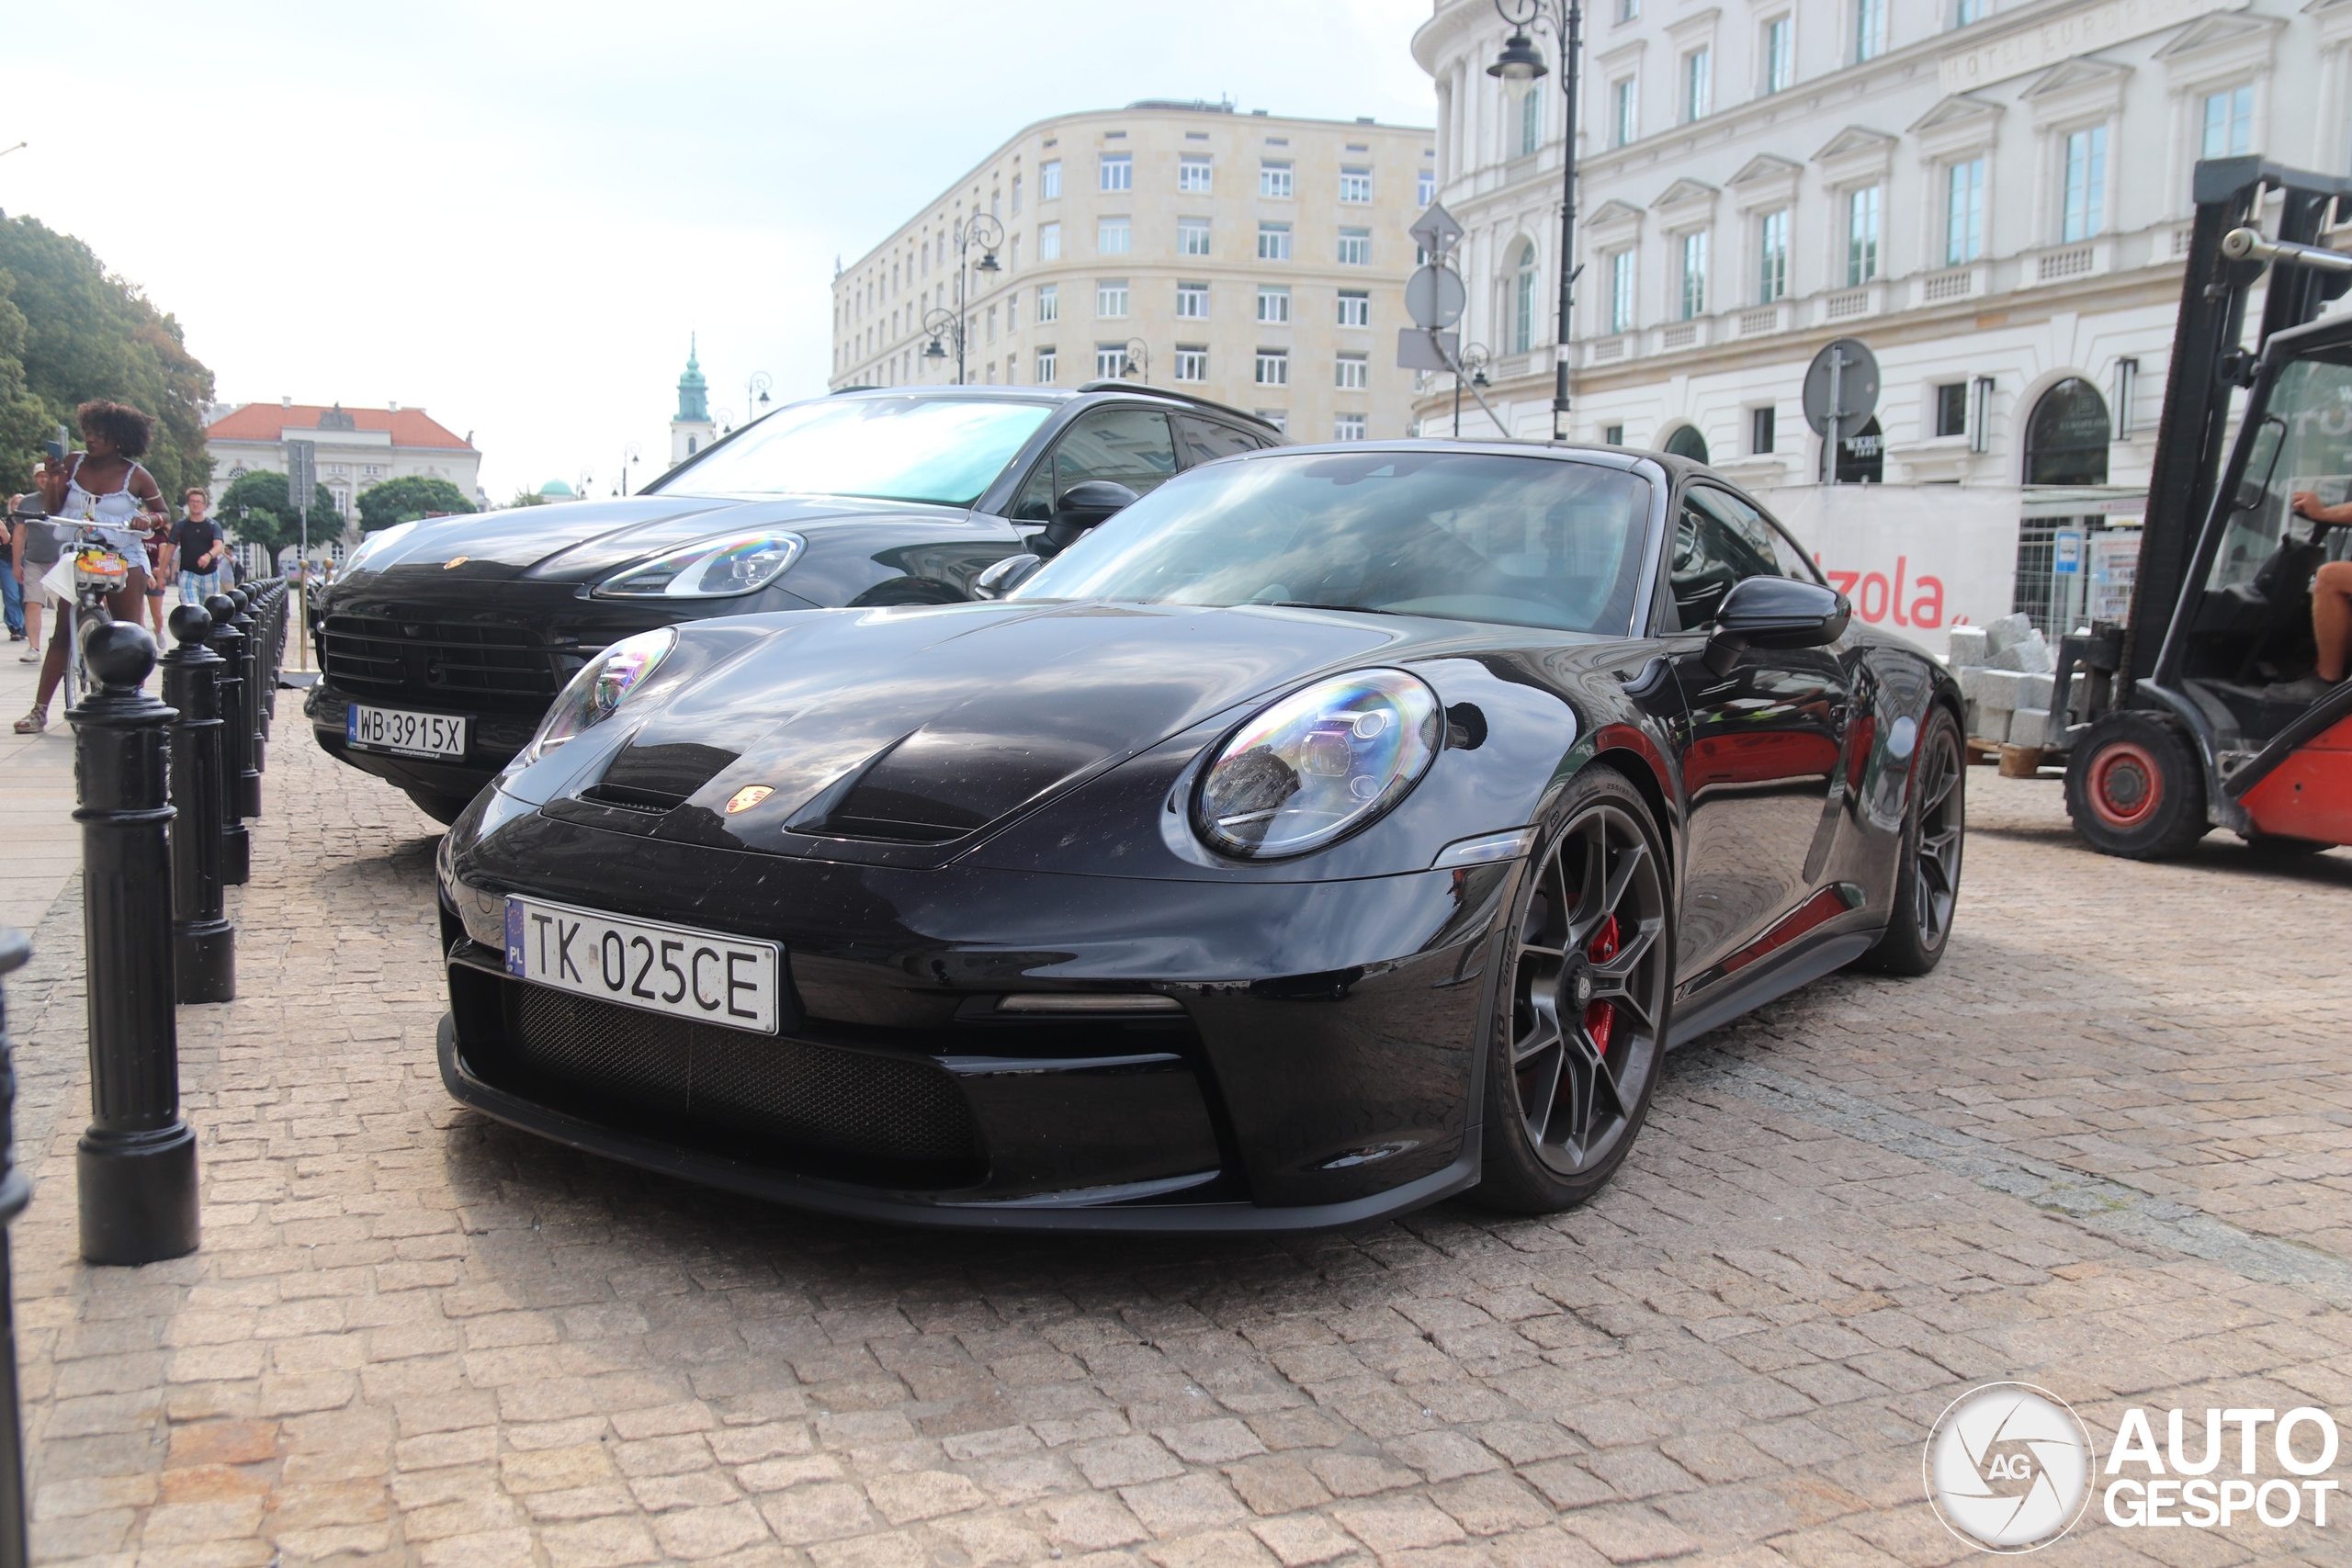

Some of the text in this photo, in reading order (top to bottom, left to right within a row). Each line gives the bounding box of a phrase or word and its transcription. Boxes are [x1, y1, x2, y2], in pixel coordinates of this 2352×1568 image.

[1946, 39, 2030, 81] HOTEL
[1814, 552, 1943, 629] zola
[349, 727, 356, 736] PL
[361, 709, 459, 751] WB 3915X
[390, 747, 441, 759] www.enterpriserentacar.pl
[510, 946, 523, 964] PL
[532, 913, 758, 1020] TK 025CE
[1503, 925, 1517, 987] CORSA
